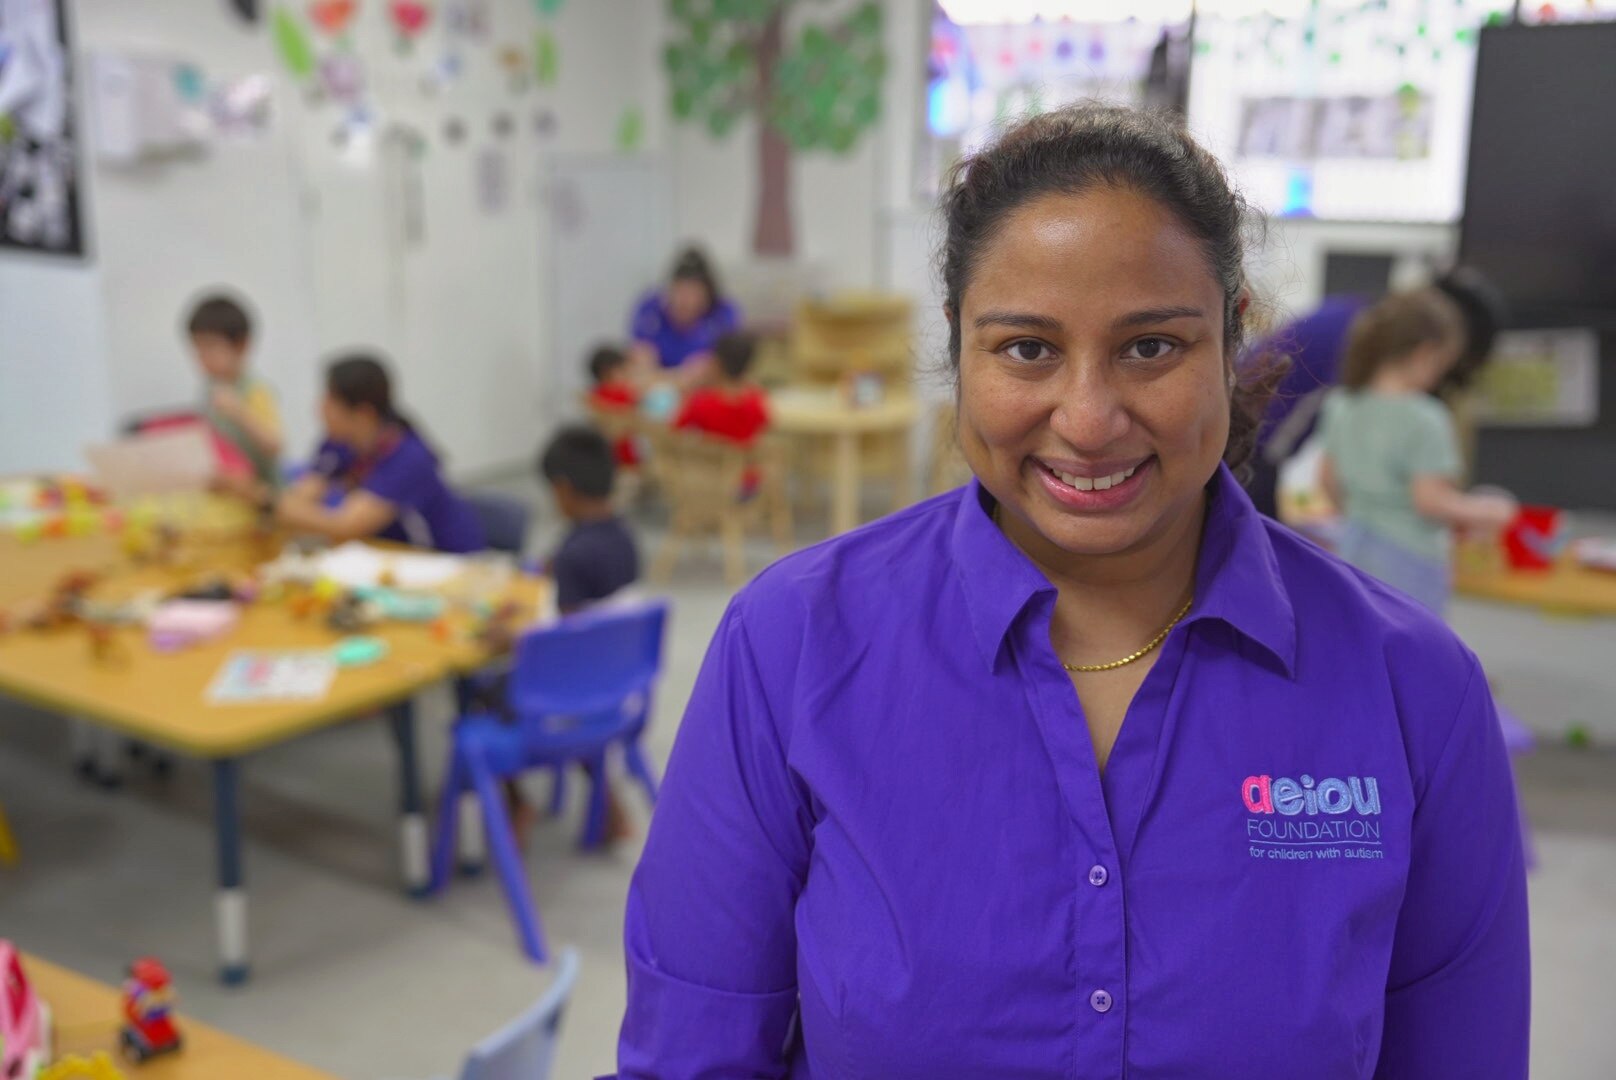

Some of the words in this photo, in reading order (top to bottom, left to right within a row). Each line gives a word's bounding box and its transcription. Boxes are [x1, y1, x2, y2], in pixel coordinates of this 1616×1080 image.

[1241, 774, 1382, 816] aeiou
[1247, 818, 1381, 840] FOUNDATION
[1249, 845, 1265, 858] for
[1267, 847, 1313, 860] children
[1315, 847, 1341, 859] with
[1344, 847, 1384, 859] autism
